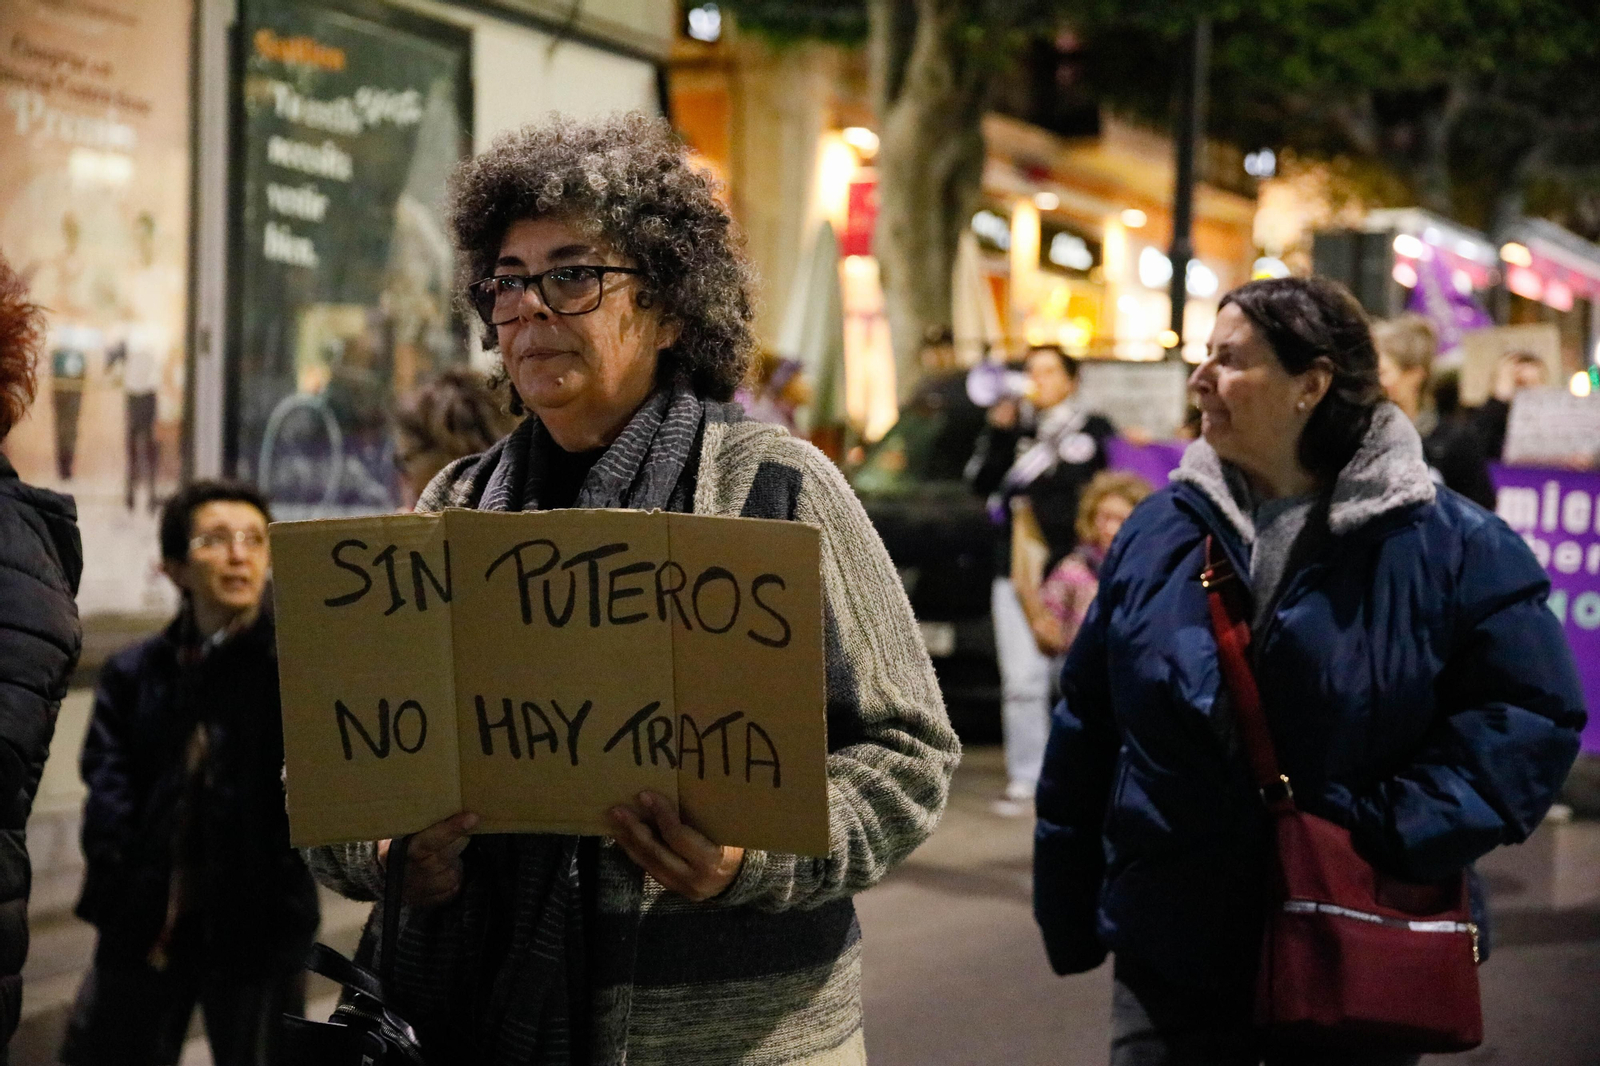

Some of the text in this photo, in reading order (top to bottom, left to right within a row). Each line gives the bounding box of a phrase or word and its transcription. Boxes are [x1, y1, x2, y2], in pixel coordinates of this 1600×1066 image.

[324, 538, 792, 649] SIN PUTEROS
[334, 694, 782, 789] NO HAY TRATA
